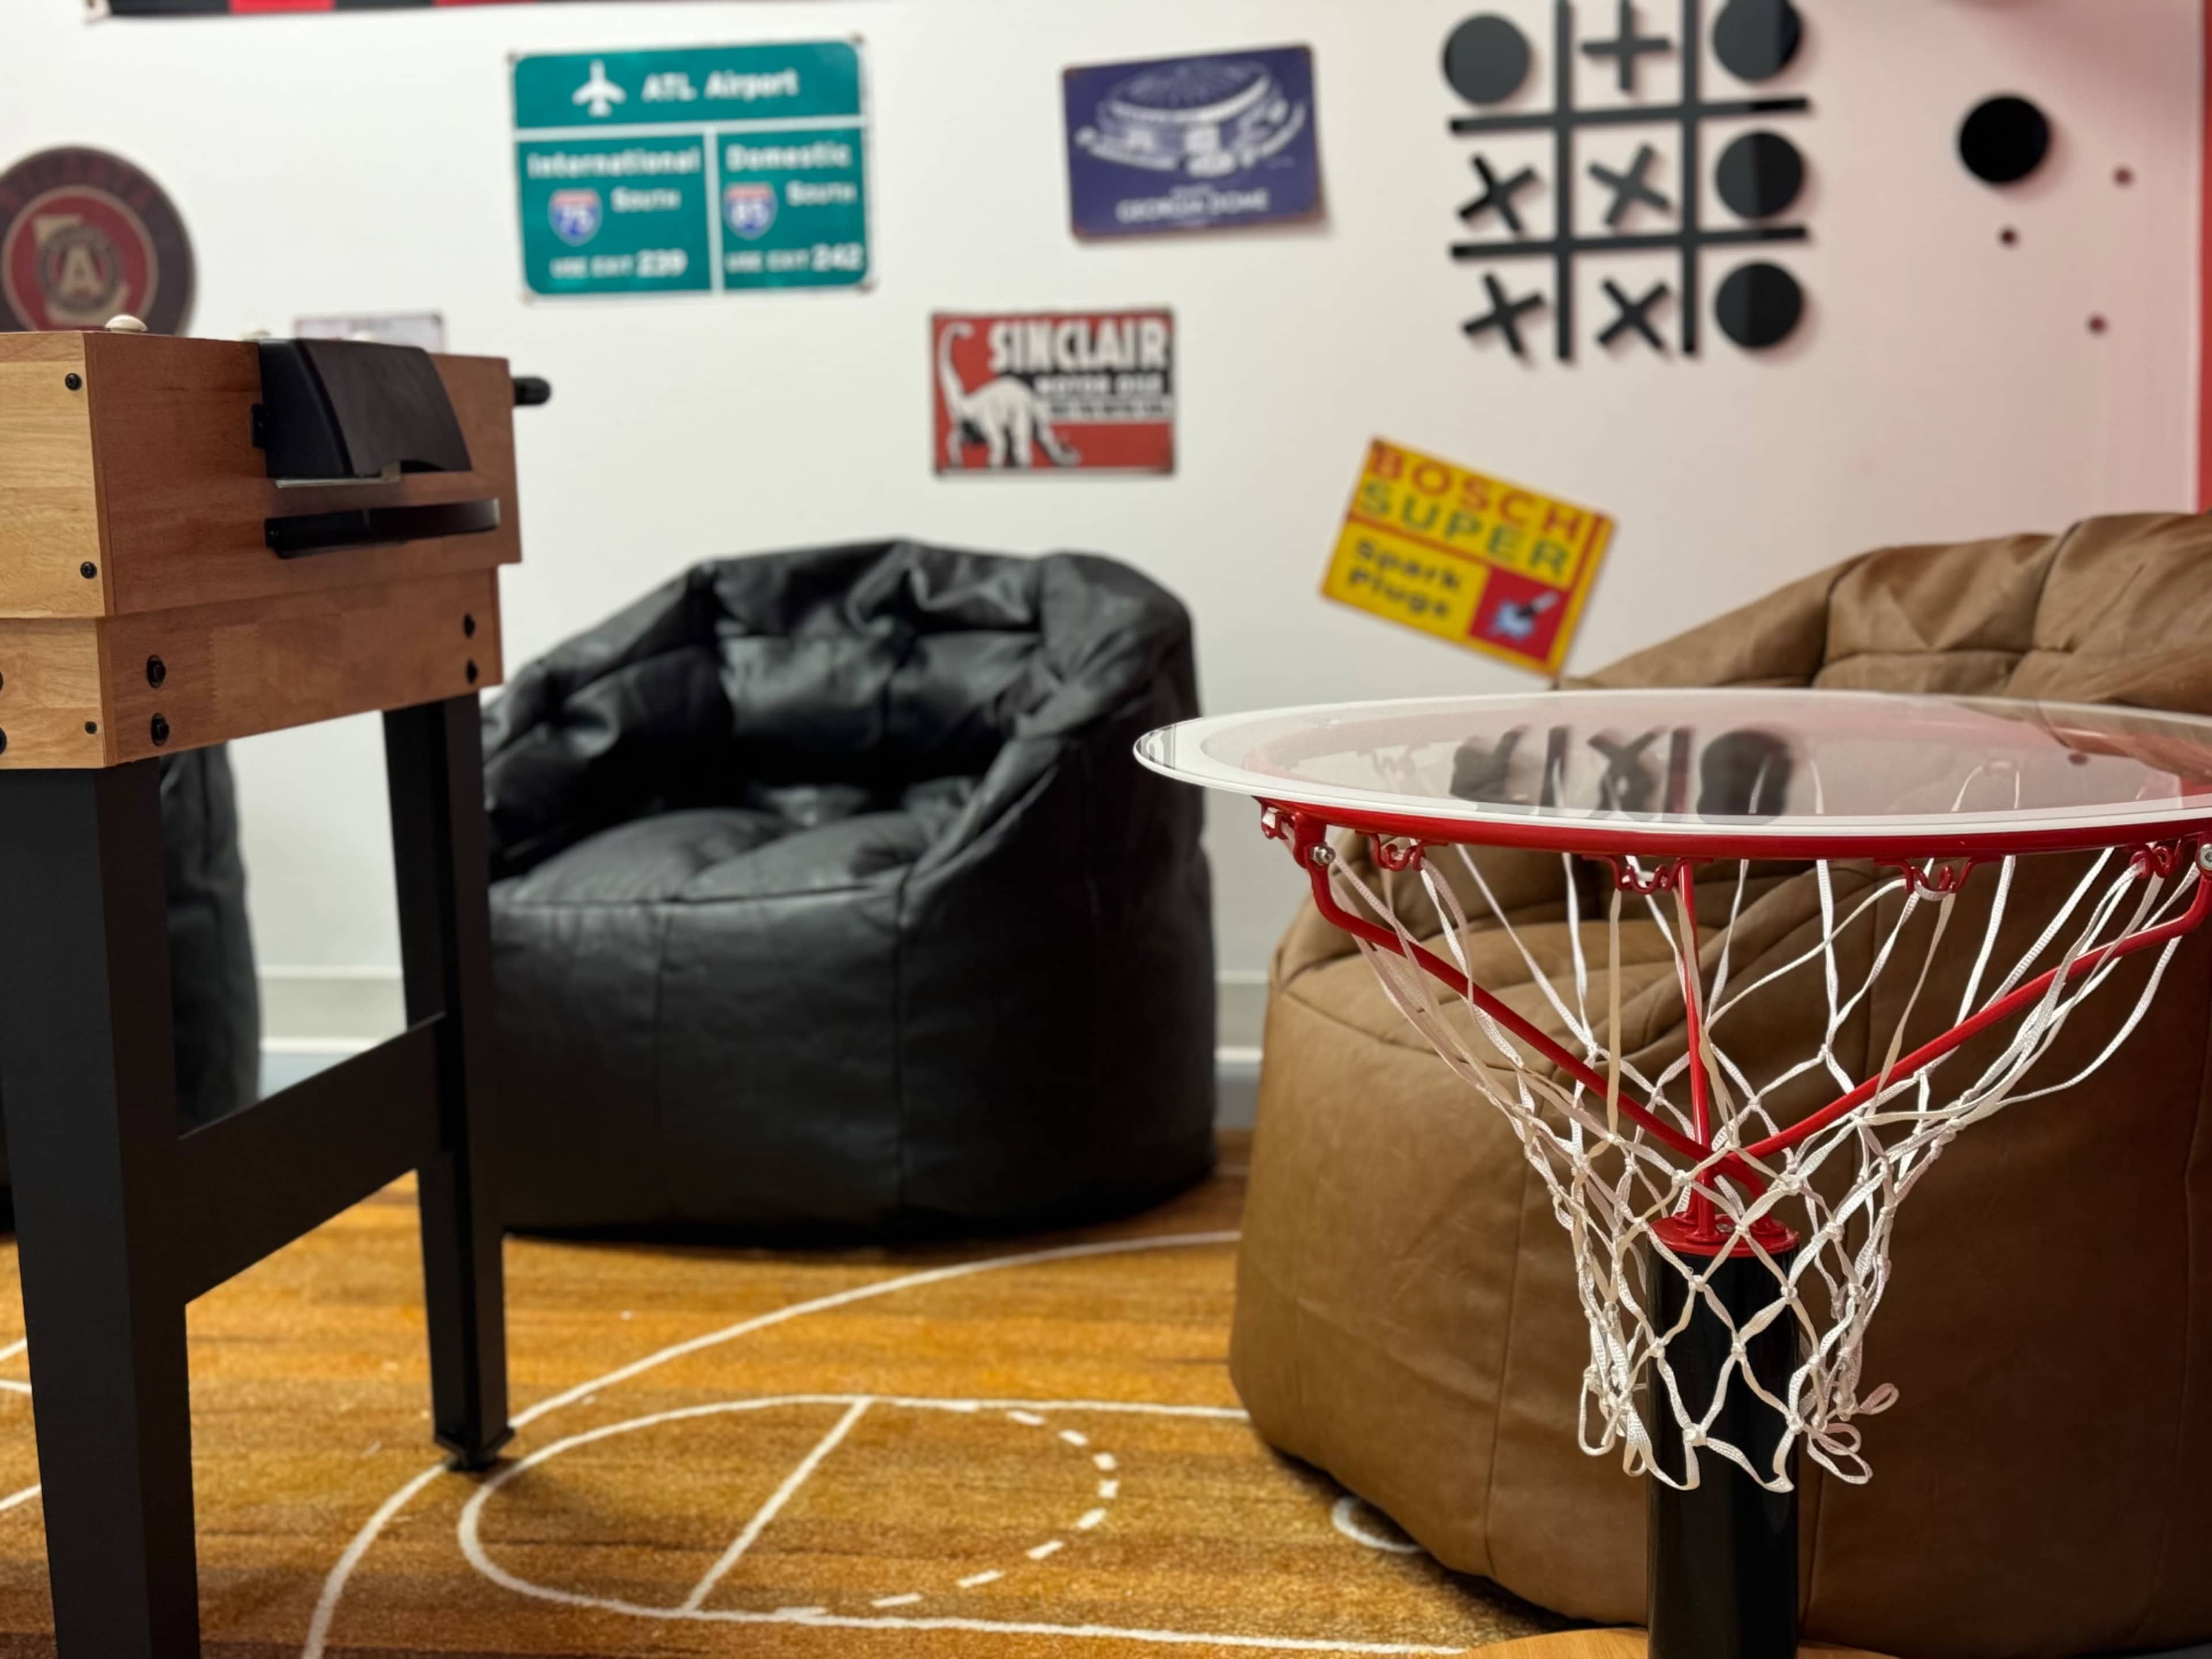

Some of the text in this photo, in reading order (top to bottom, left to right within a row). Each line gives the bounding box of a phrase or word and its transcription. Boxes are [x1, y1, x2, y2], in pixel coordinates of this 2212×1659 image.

[642, 67, 800, 103] ATL Airport
[527, 146, 701, 180] International
[725, 141, 852, 172] Domestic
[1208, 187, 1268, 215] DOME
[635, 247, 688, 277] 239
[810, 241, 864, 271] 242
[988, 317, 1167, 374] SINCLAIR
[1371, 446, 1583, 543] BOSCH
[1361, 479, 1570, 578] SUPER
[1356, 538, 1460, 591] Spark
[1348, 567, 1449, 618] Plugs
